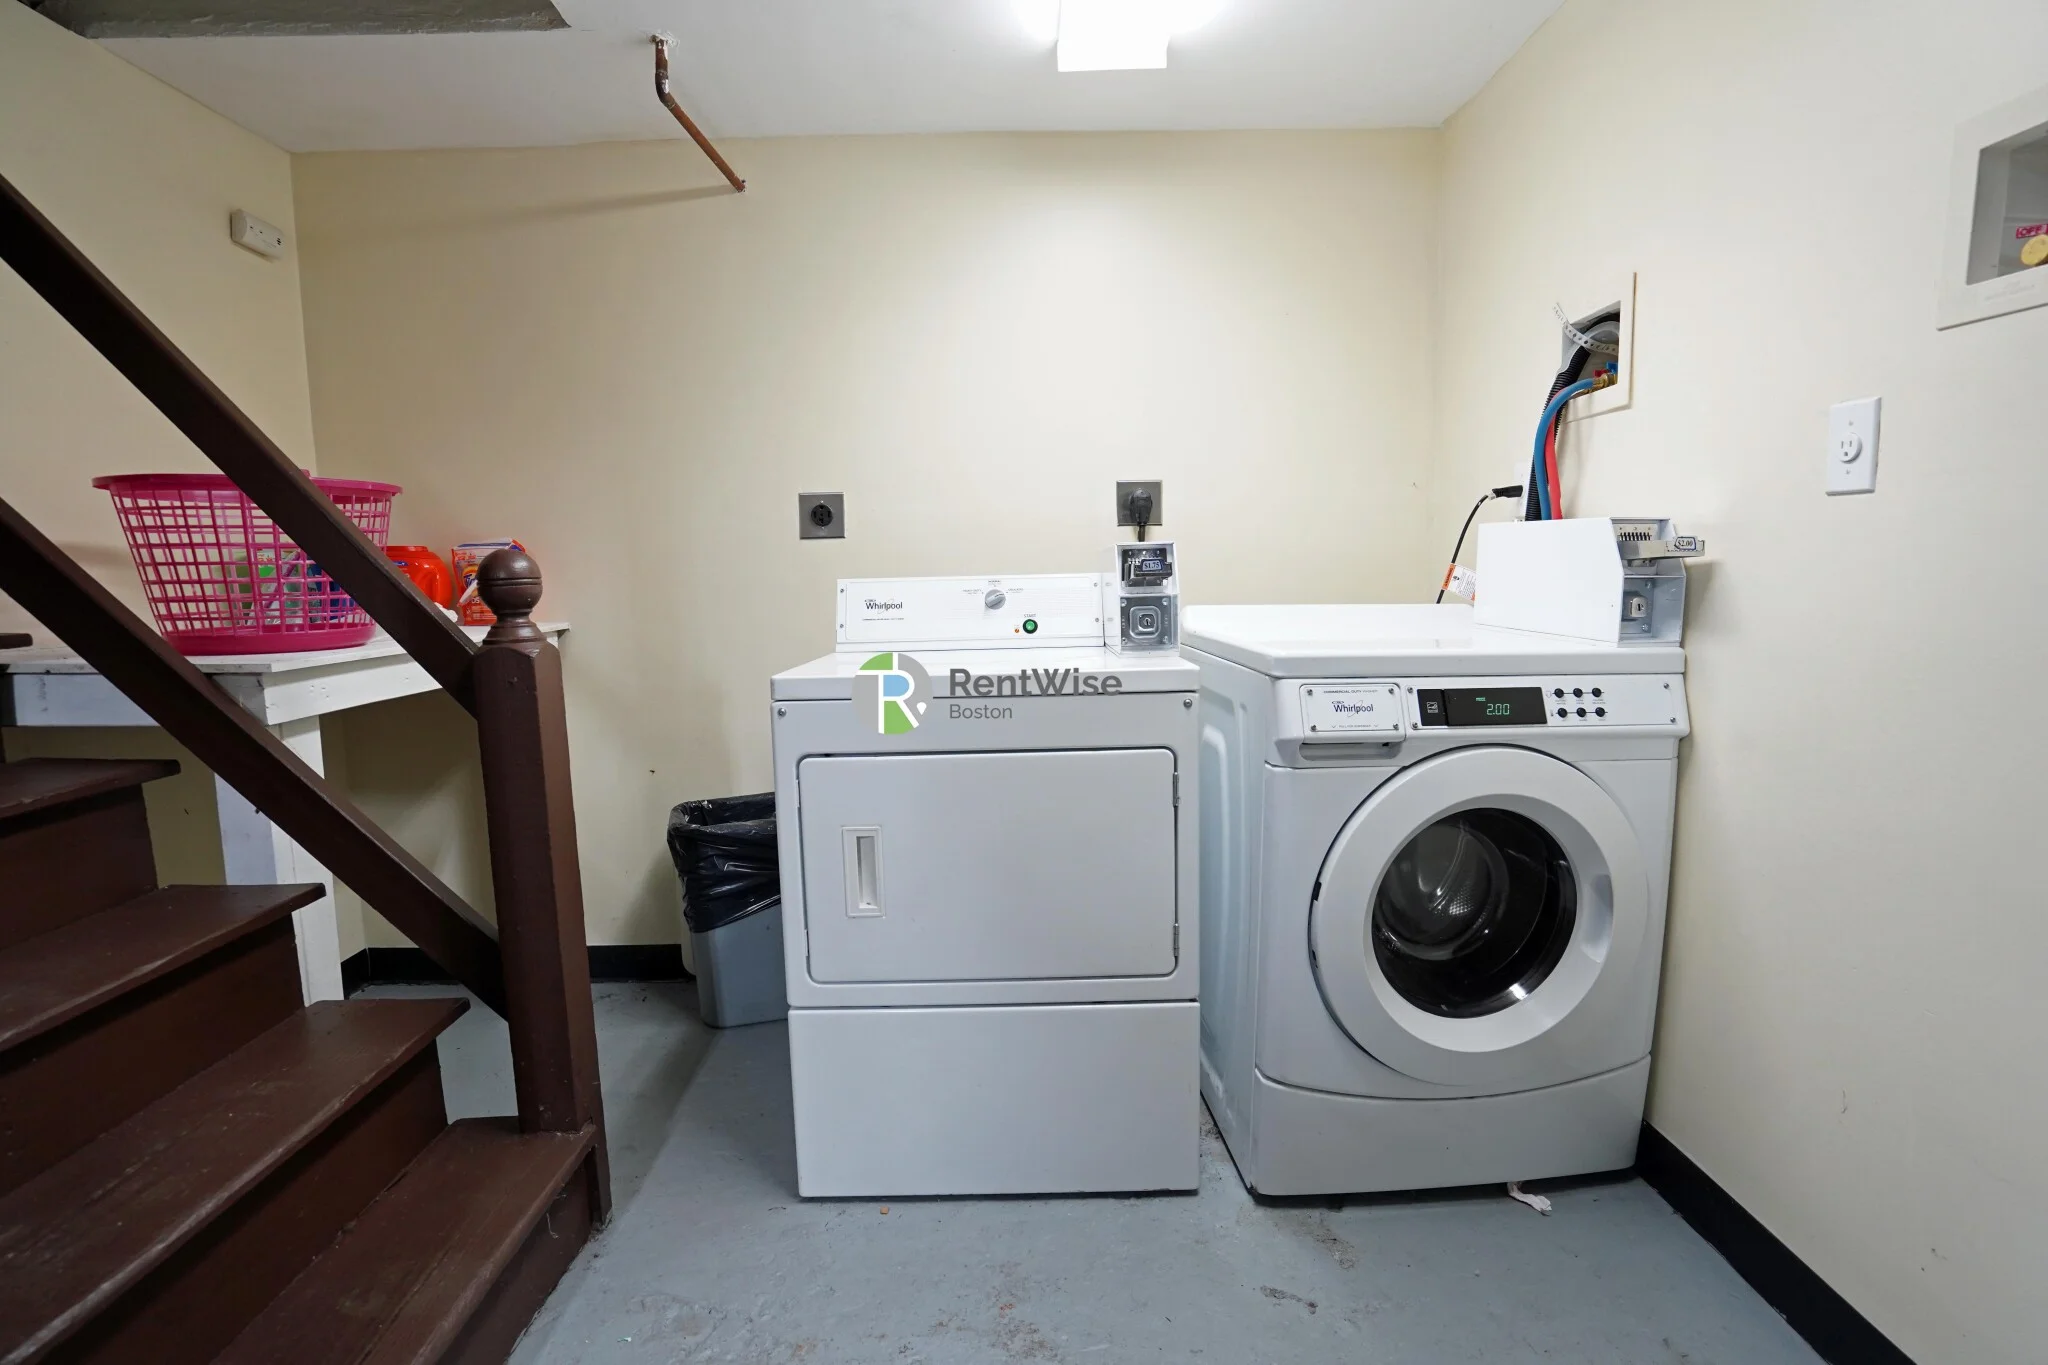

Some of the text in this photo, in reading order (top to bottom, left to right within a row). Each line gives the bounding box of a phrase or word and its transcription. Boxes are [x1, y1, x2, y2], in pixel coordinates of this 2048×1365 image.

[865, 601, 903, 611] Whirlpool
[1333, 703, 1374, 714] Whirlpool
[1486, 703, 1510, 715] 2.00
